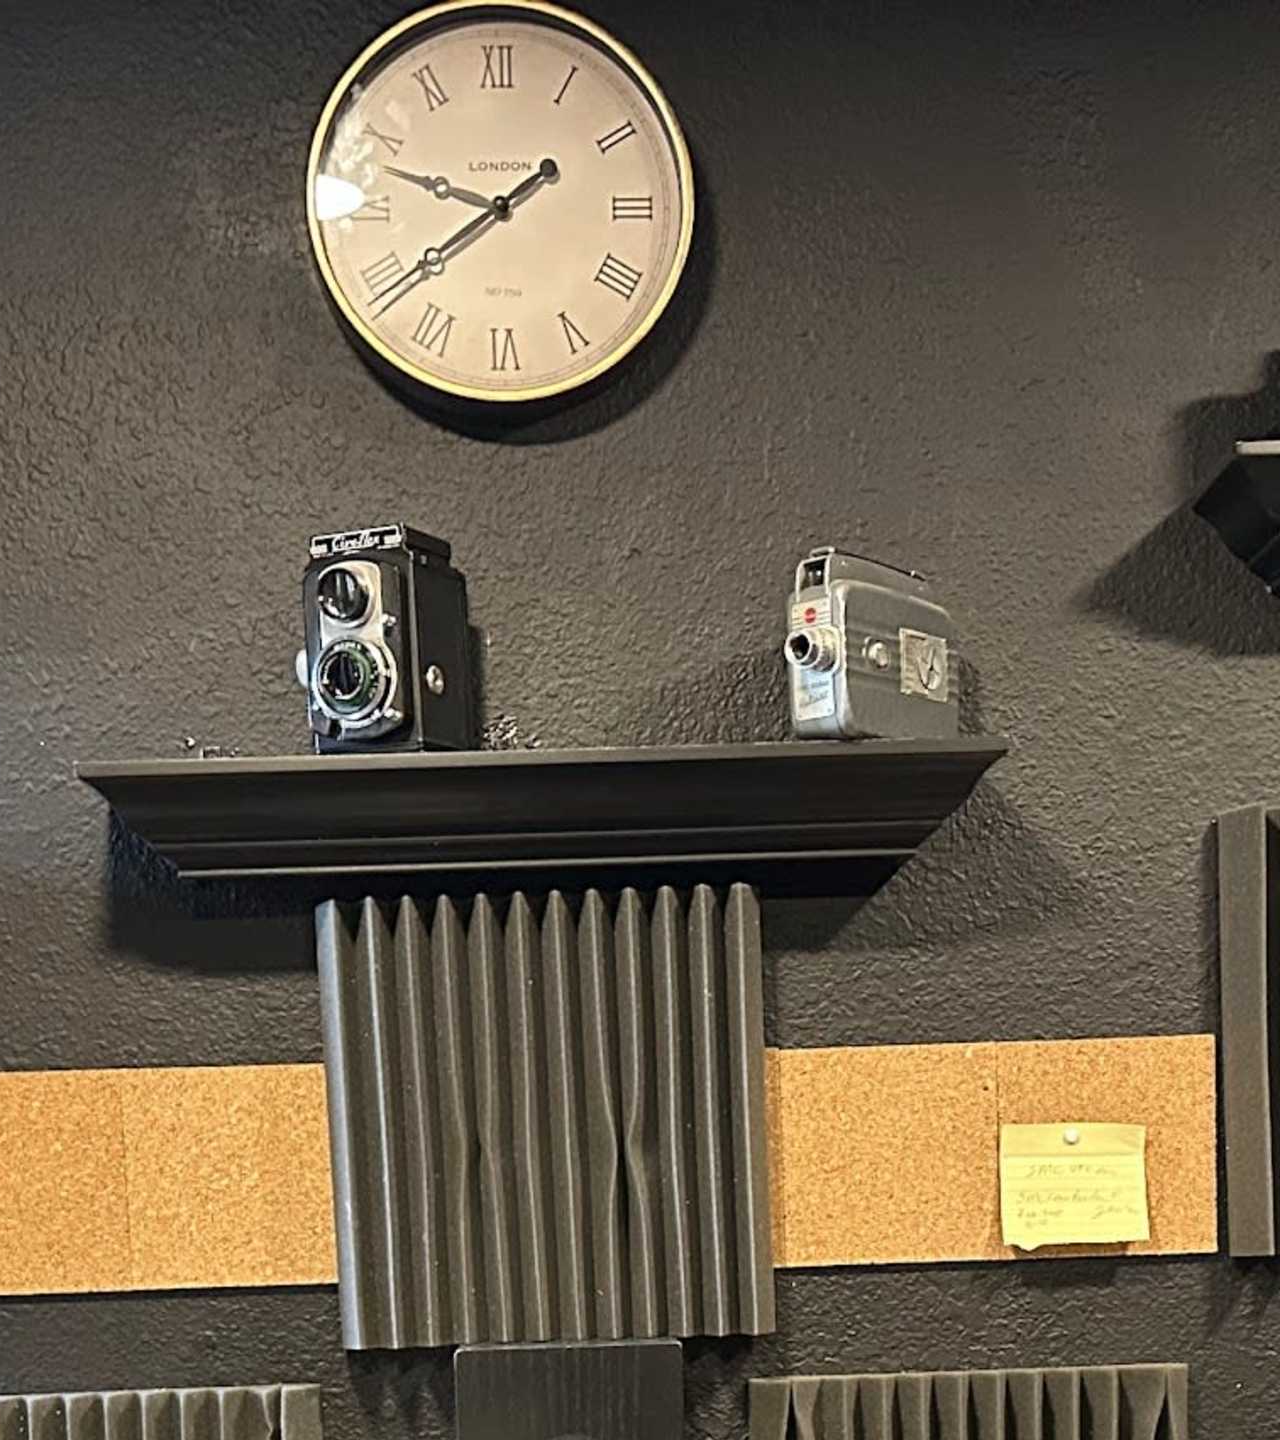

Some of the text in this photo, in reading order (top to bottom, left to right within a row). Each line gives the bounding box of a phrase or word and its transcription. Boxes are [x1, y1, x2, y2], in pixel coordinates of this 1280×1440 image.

[411, 63, 450, 111] XI
[480, 44, 514, 89] XII
[596, 120, 637, 154] II
[467, 161, 533, 173] LONDON
[612, 196, 654, 221] III
[490, 328, 521, 372] VI
[557, 311, 591, 355] V
